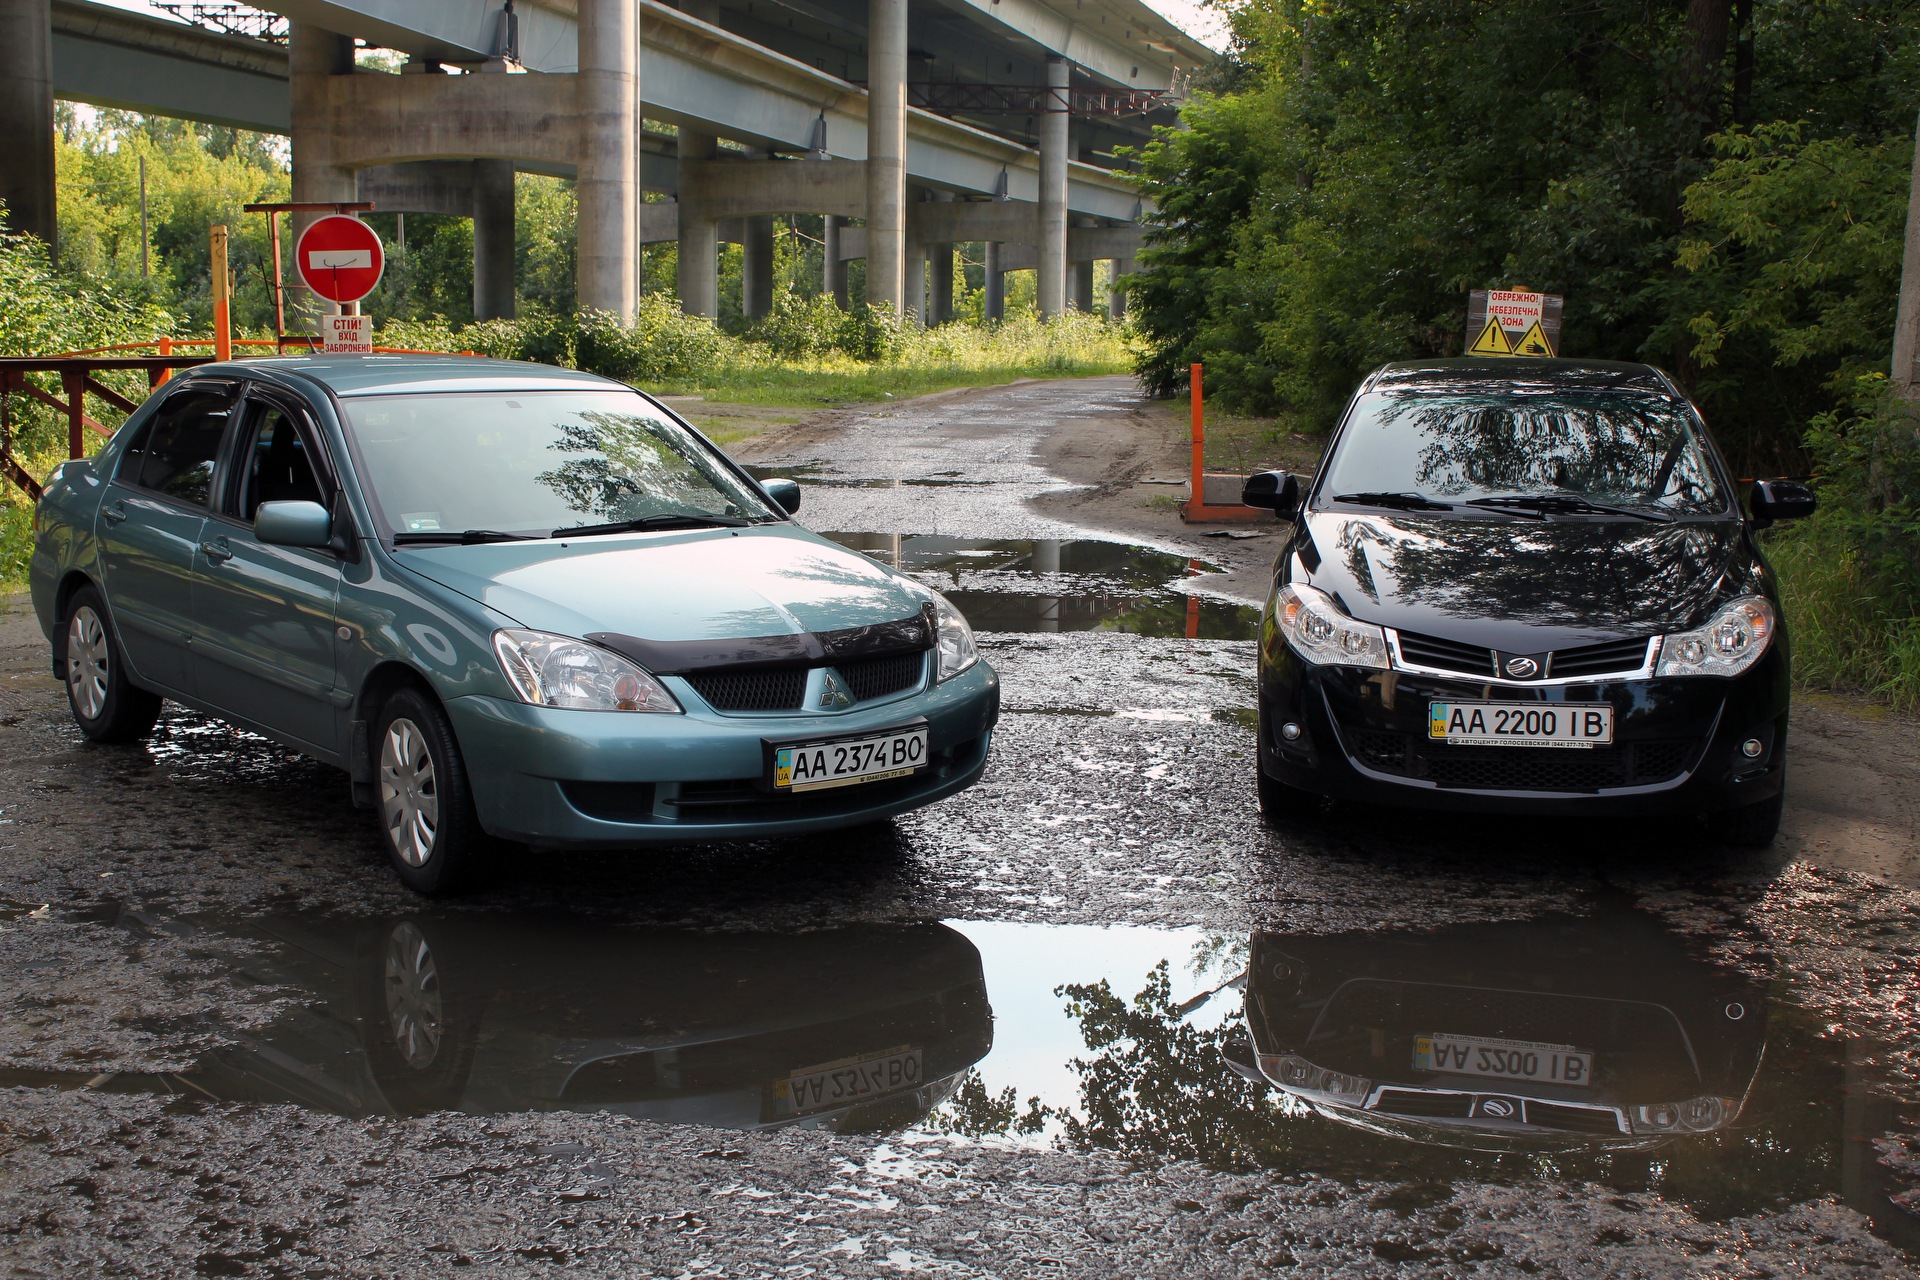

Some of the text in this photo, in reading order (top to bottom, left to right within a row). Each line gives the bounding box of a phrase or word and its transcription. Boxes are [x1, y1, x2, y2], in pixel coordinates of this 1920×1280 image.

[1491, 292, 1539, 303] ОБЕРЕЖНО!
[1488, 305, 1539, 317] НЕБЕЗПЕЧНА
[333, 317, 362, 330] СТІЙ!
[1501, 317, 1524, 327] ЗОНА
[338, 332, 358, 342] ВХІД
[325, 343, 371, 353] ЗАБОРОНЕНО
[1448, 708, 1604, 738] AA 2200 IB
[1433, 725, 1446, 733] UA
[1460, 738, 1499, 746] АВТОЦЕНТР
[1499, 739, 1550, 747] ГОЛОСЕЕВСКИЙ
[792, 735, 922, 780] AA 2374 BO
[778, 773, 789, 781] UA
